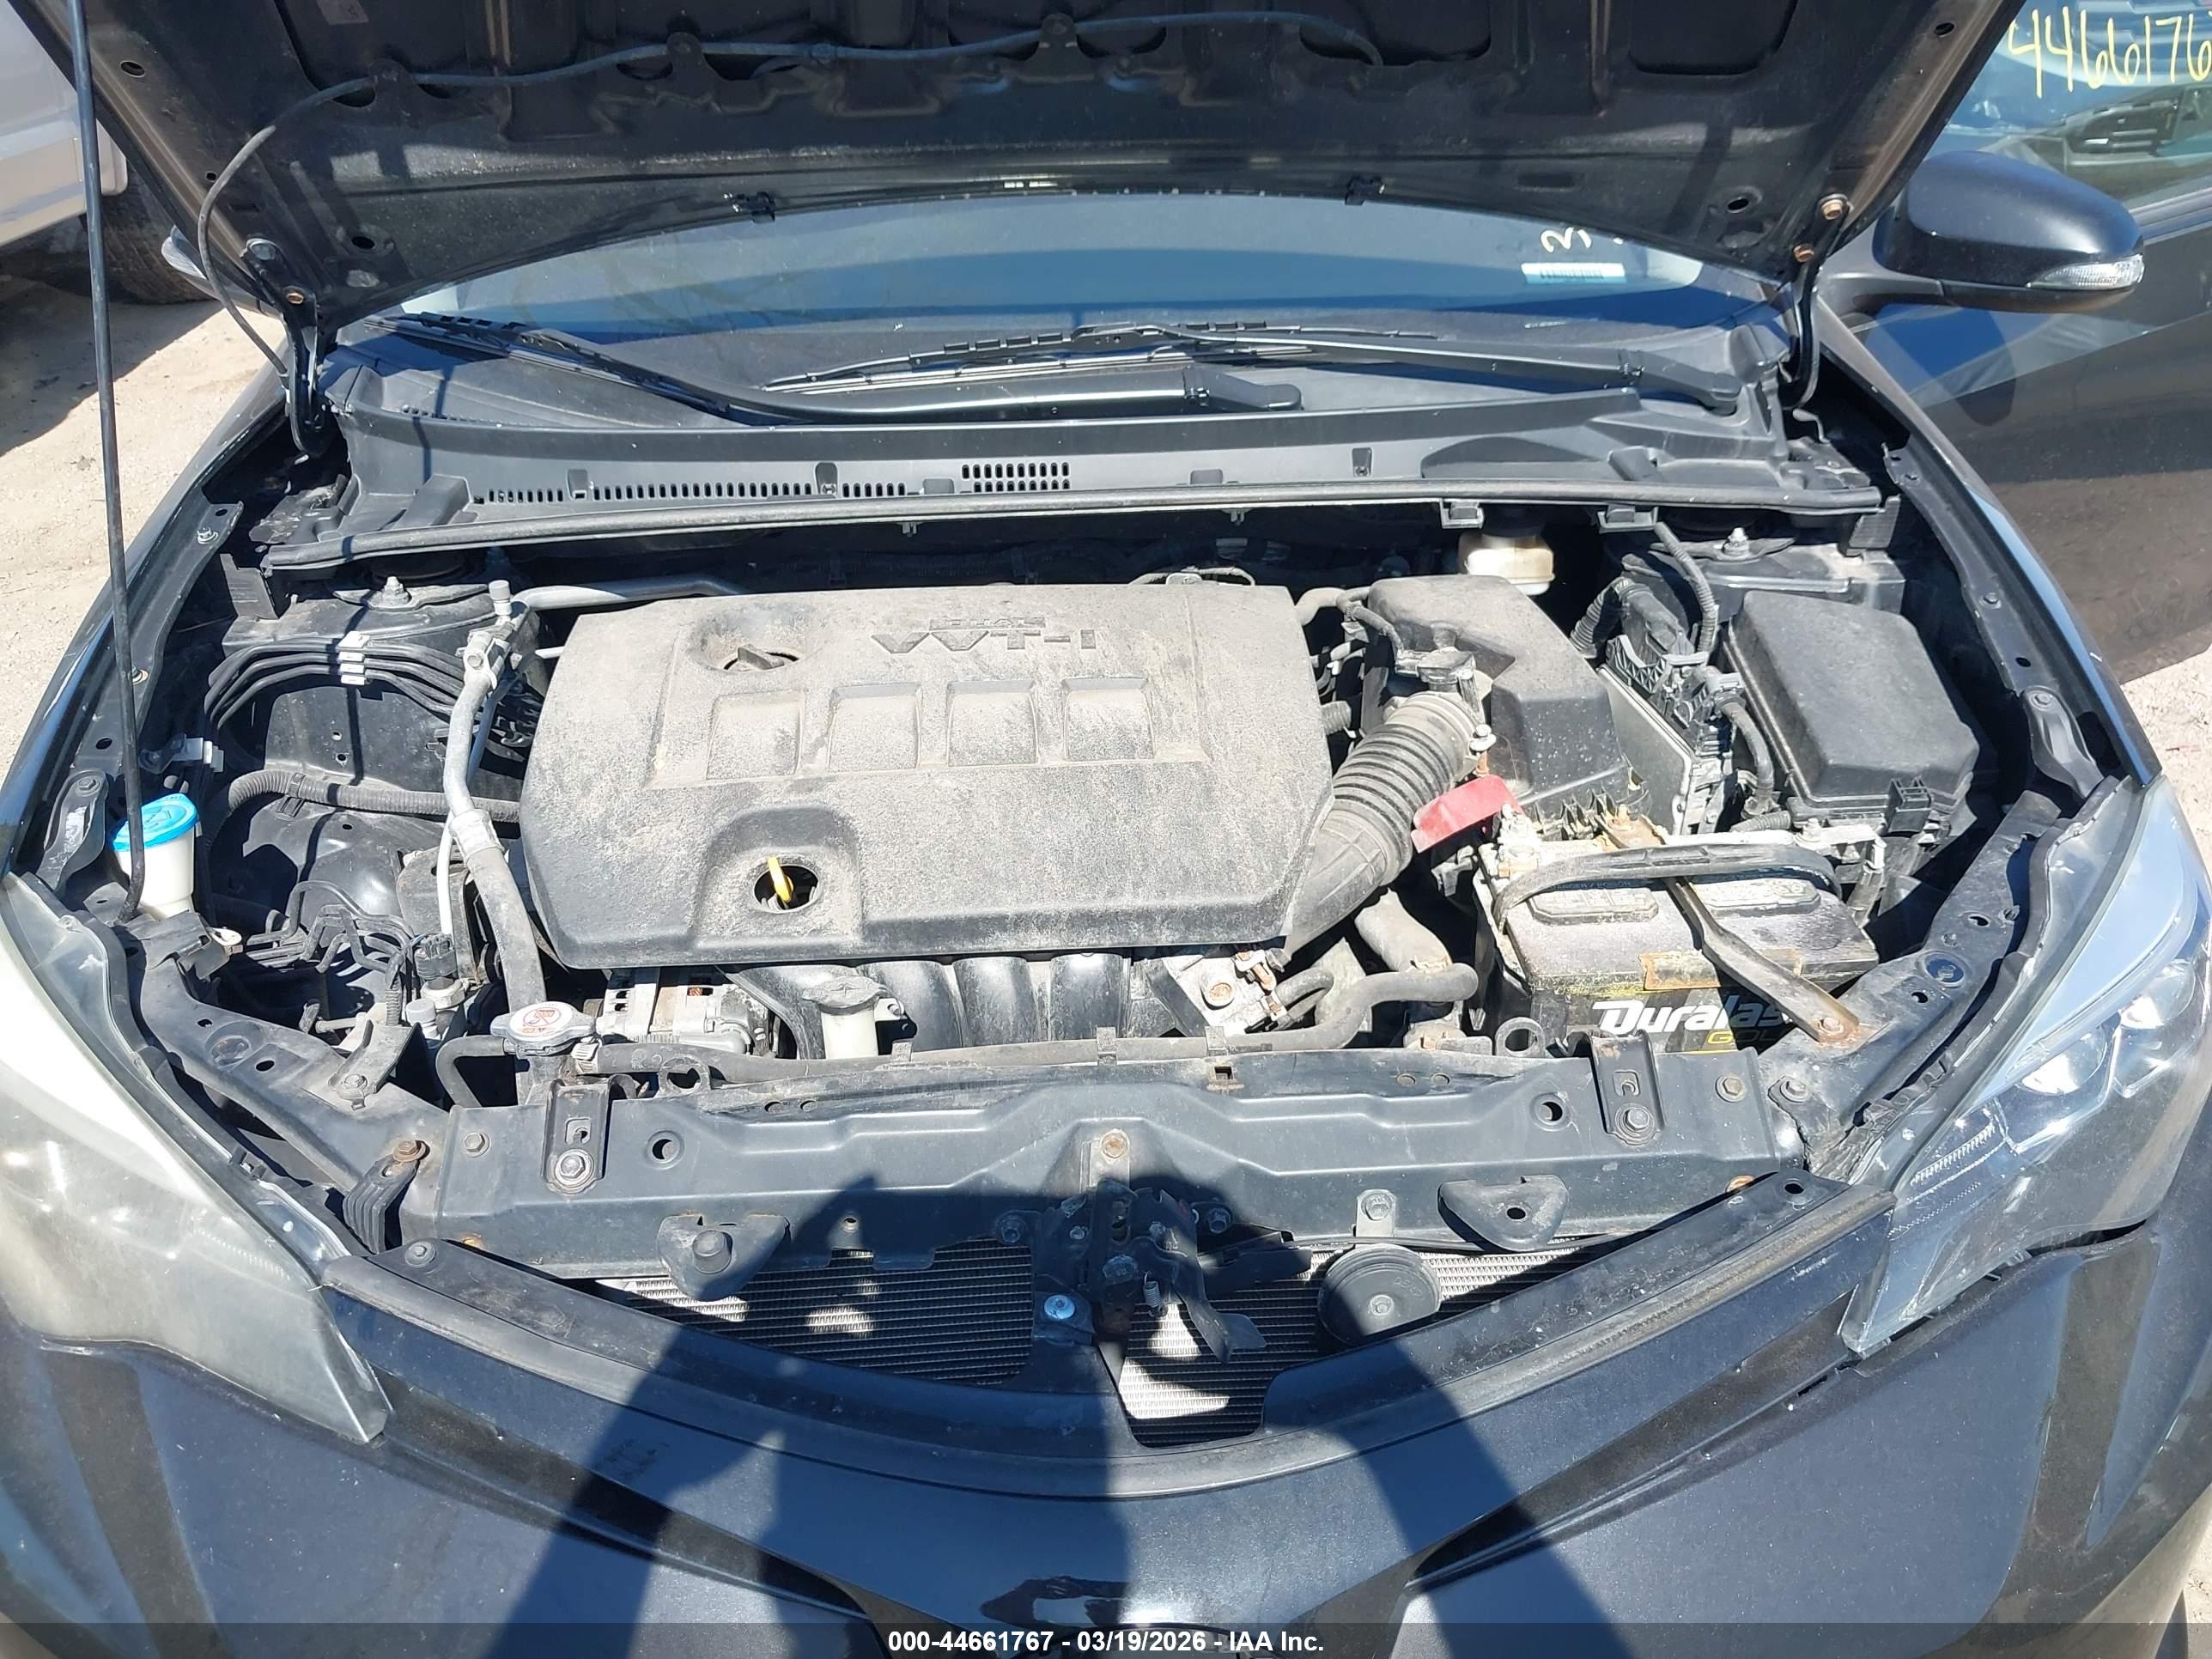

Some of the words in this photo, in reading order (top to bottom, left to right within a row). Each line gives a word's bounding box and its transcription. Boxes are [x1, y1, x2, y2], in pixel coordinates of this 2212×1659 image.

[2007, 6, 2212, 98] 4466176
[1592, 994, 1785, 1035] Duralas
[1707, 1030, 1776, 1045] GOL
